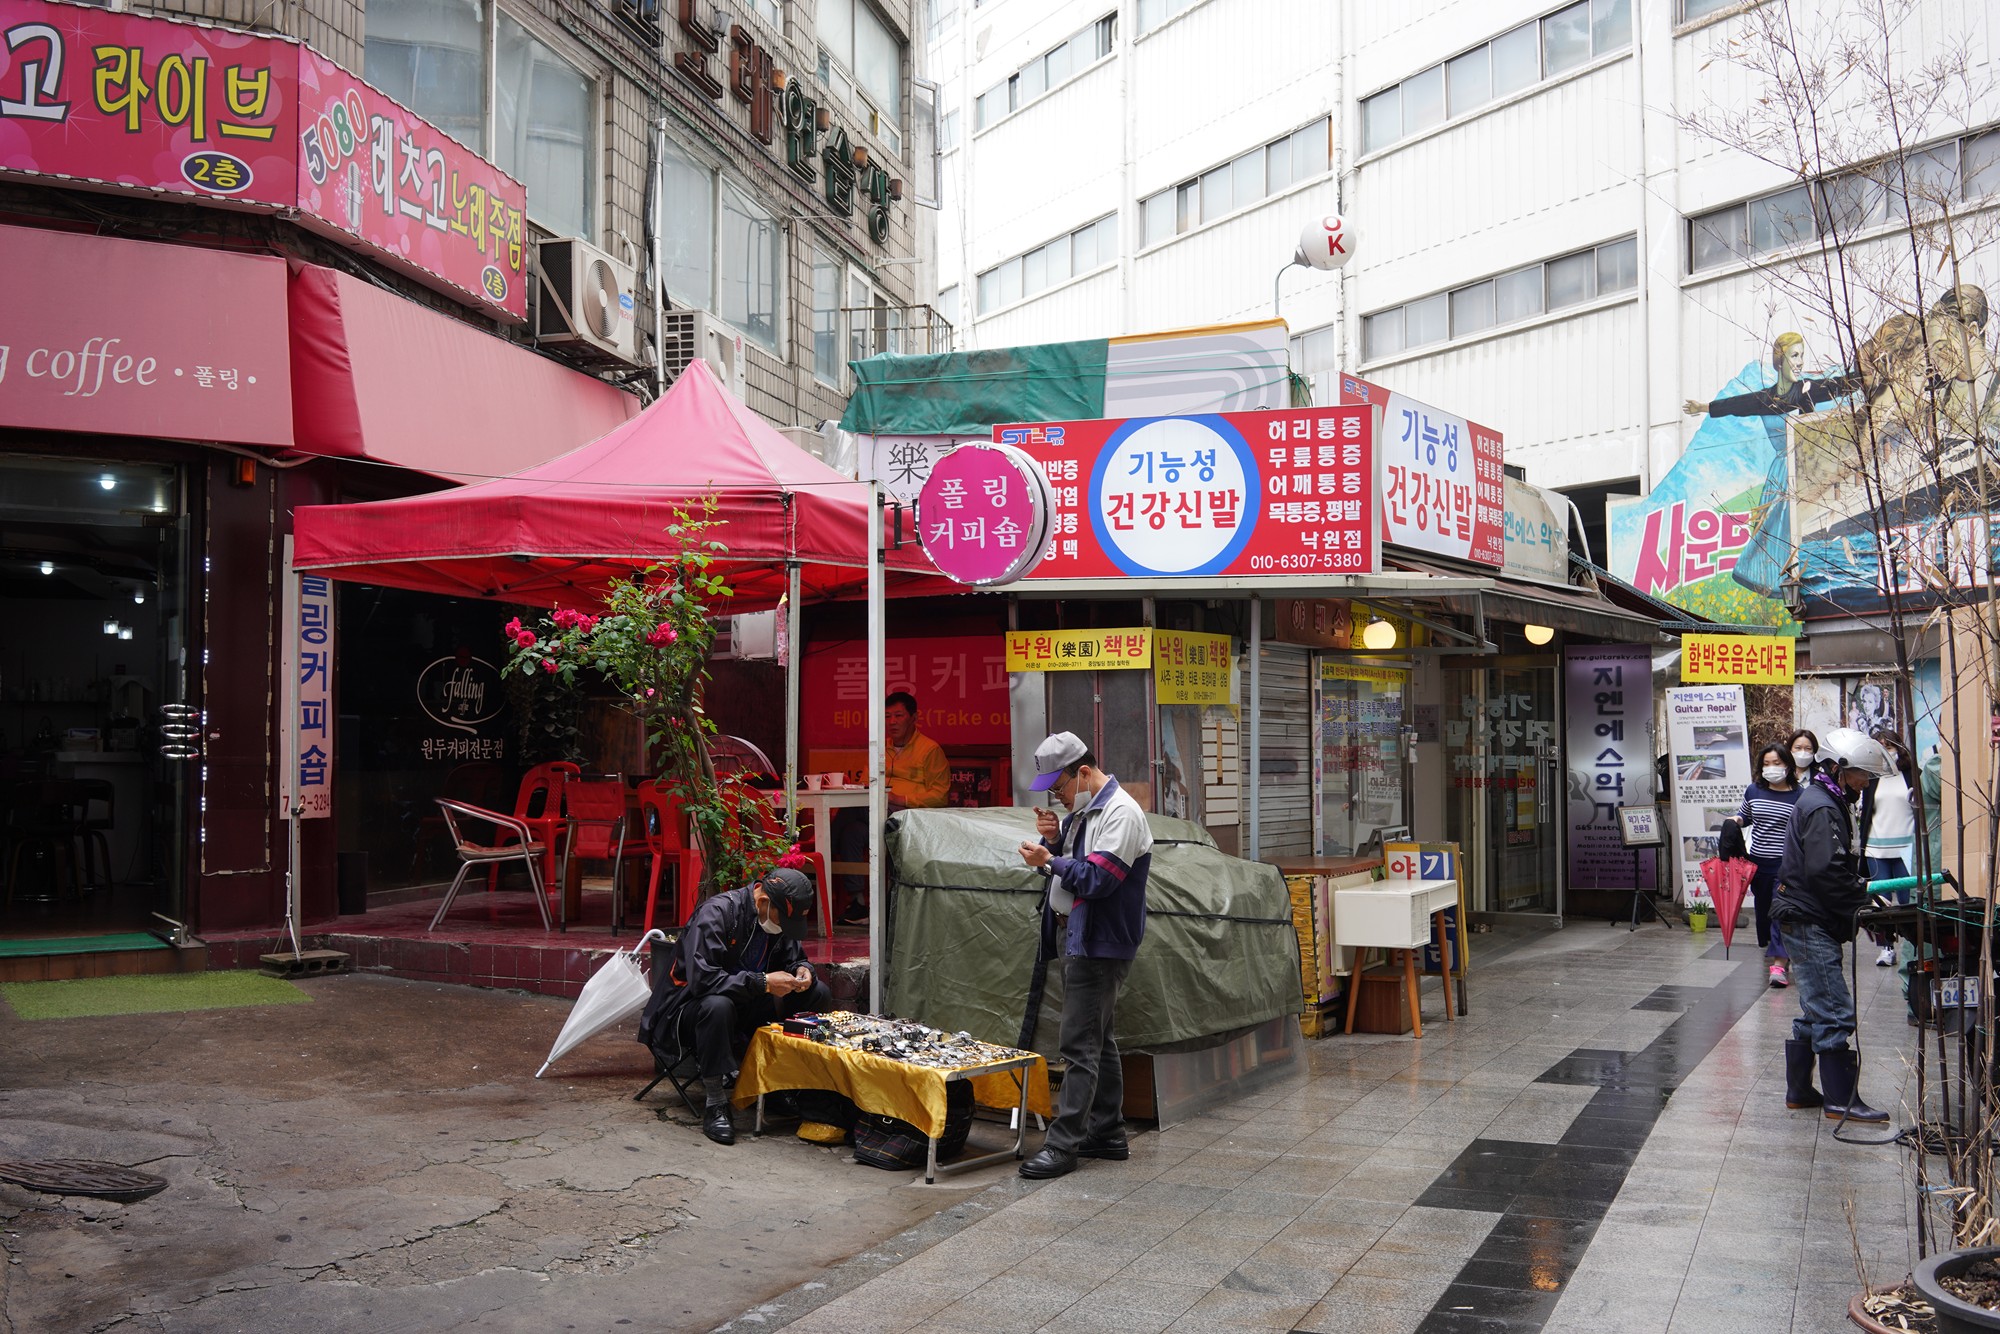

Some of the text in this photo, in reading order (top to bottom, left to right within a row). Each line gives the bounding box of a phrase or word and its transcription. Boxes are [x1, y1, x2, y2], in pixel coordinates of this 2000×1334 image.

[93, 44, 276, 142] 라이브
[303, 88, 368, 185] 5080
[193, 157, 242, 188] 2층
[484, 271, 509, 300] 2층
[26, 337, 157, 397] coffee
[1268, 417, 1361, 441] 허리통증
[1401, 408, 1458, 473] 기능성
[1129, 448, 1217, 484] 기능성
[1268, 444, 1361, 469] 무릎통증
[1268, 472, 1361, 496] 어깨통증
[1107, 489, 1240, 531] 건강신발
[1387, 464, 1473, 542] 건강신발
[930, 517, 1022, 549] 커피숍
[1301, 530, 1361, 550] 낙원점
[1250, 553, 1362, 569] 010-6307-5380
[1688, 642, 1788, 677] 함박웃음순대국
[441, 667, 485, 714] falling
[1673, 691, 1736, 702] 지엔에스 악기
[1675, 703, 1737, 714] Guitar Repair
[420, 737, 504, 761] 원두커피전문점
